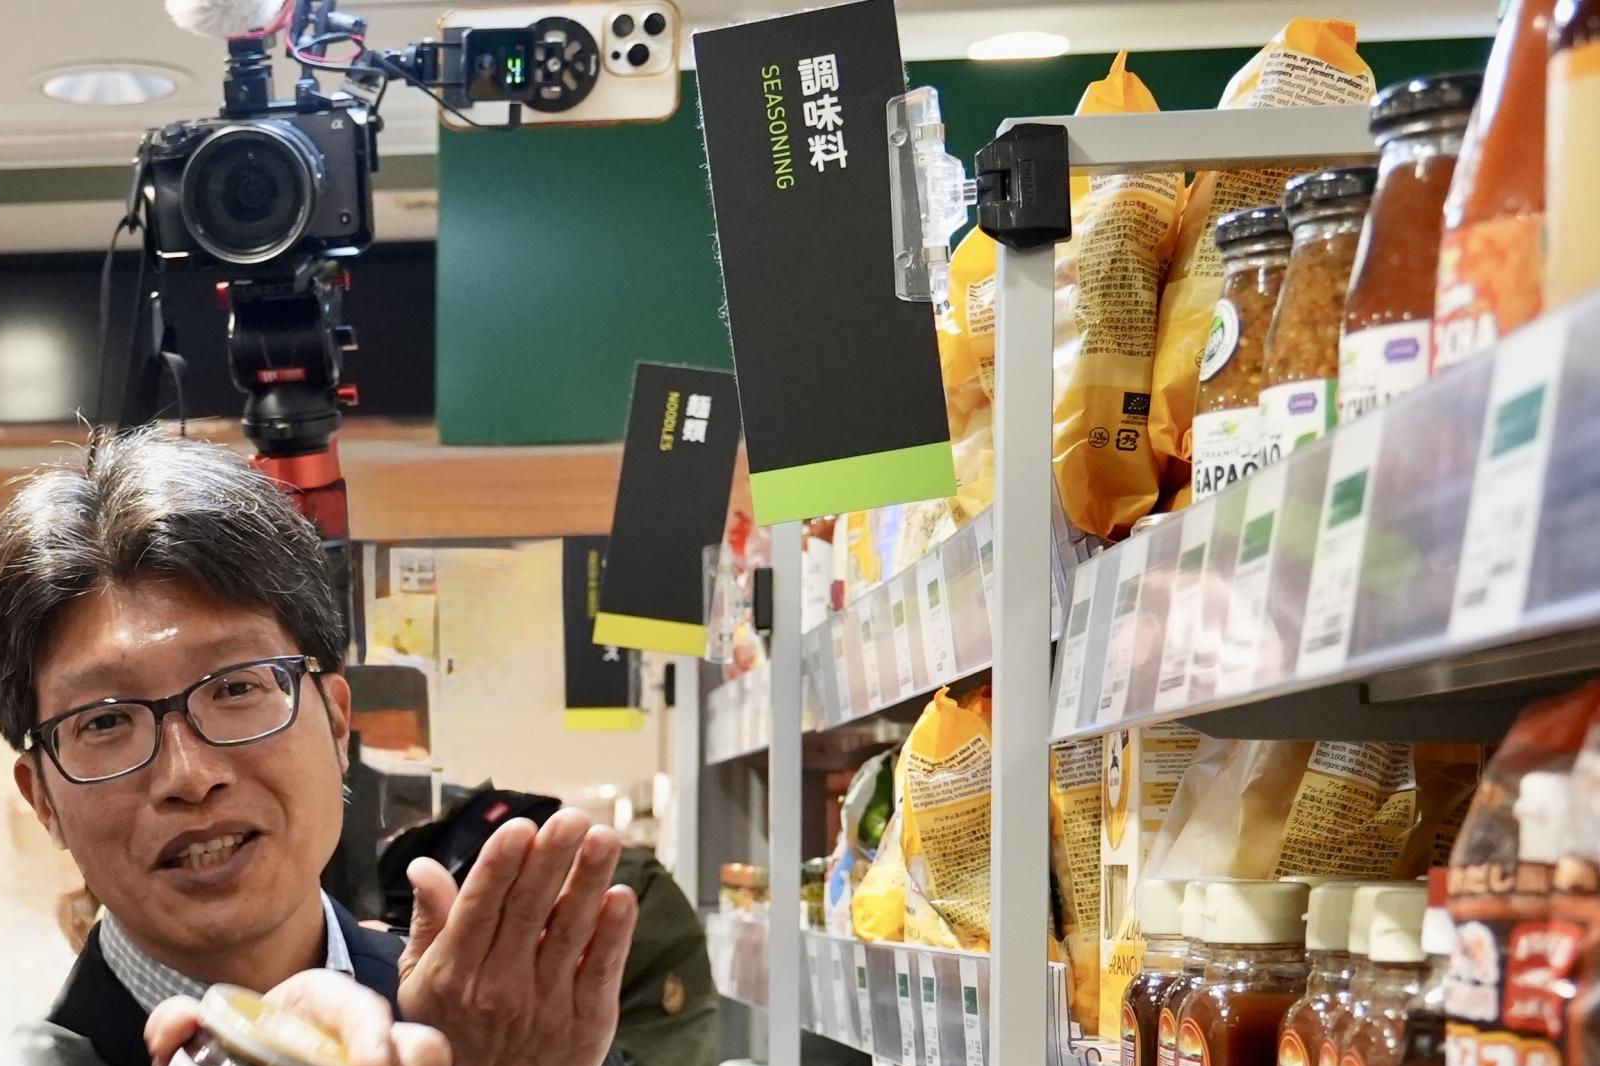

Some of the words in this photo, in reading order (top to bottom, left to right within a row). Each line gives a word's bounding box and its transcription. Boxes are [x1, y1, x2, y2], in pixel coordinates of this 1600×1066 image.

[761, 64, 795, 190] SEASONING
[798, 53, 849, 173] 調味料
[659, 391, 680, 452] NOODLES
